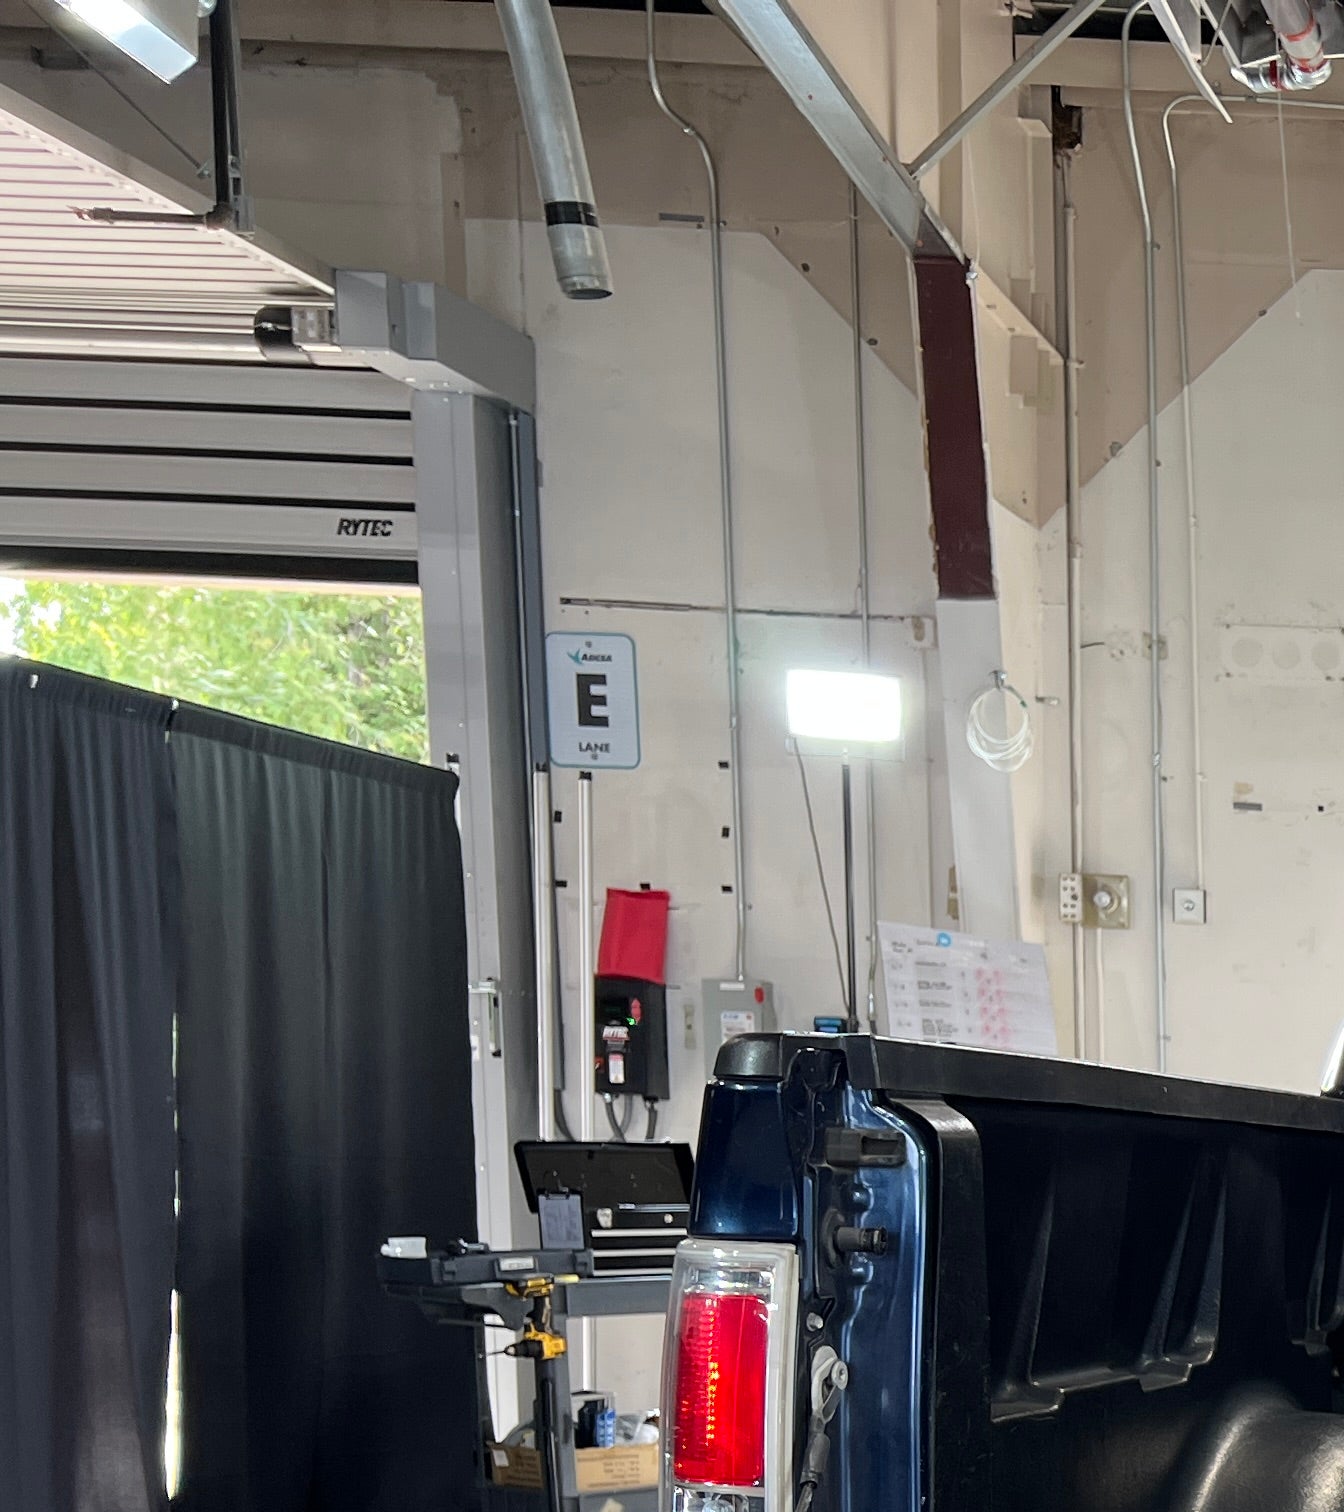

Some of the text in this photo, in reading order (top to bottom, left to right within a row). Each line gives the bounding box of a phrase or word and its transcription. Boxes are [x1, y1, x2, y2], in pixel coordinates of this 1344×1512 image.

[337, 518, 393, 536] RYTEC
[581, 653, 612, 662] ADESA
[576, 673, 609, 727] E
[578, 742, 611, 753] LANE
